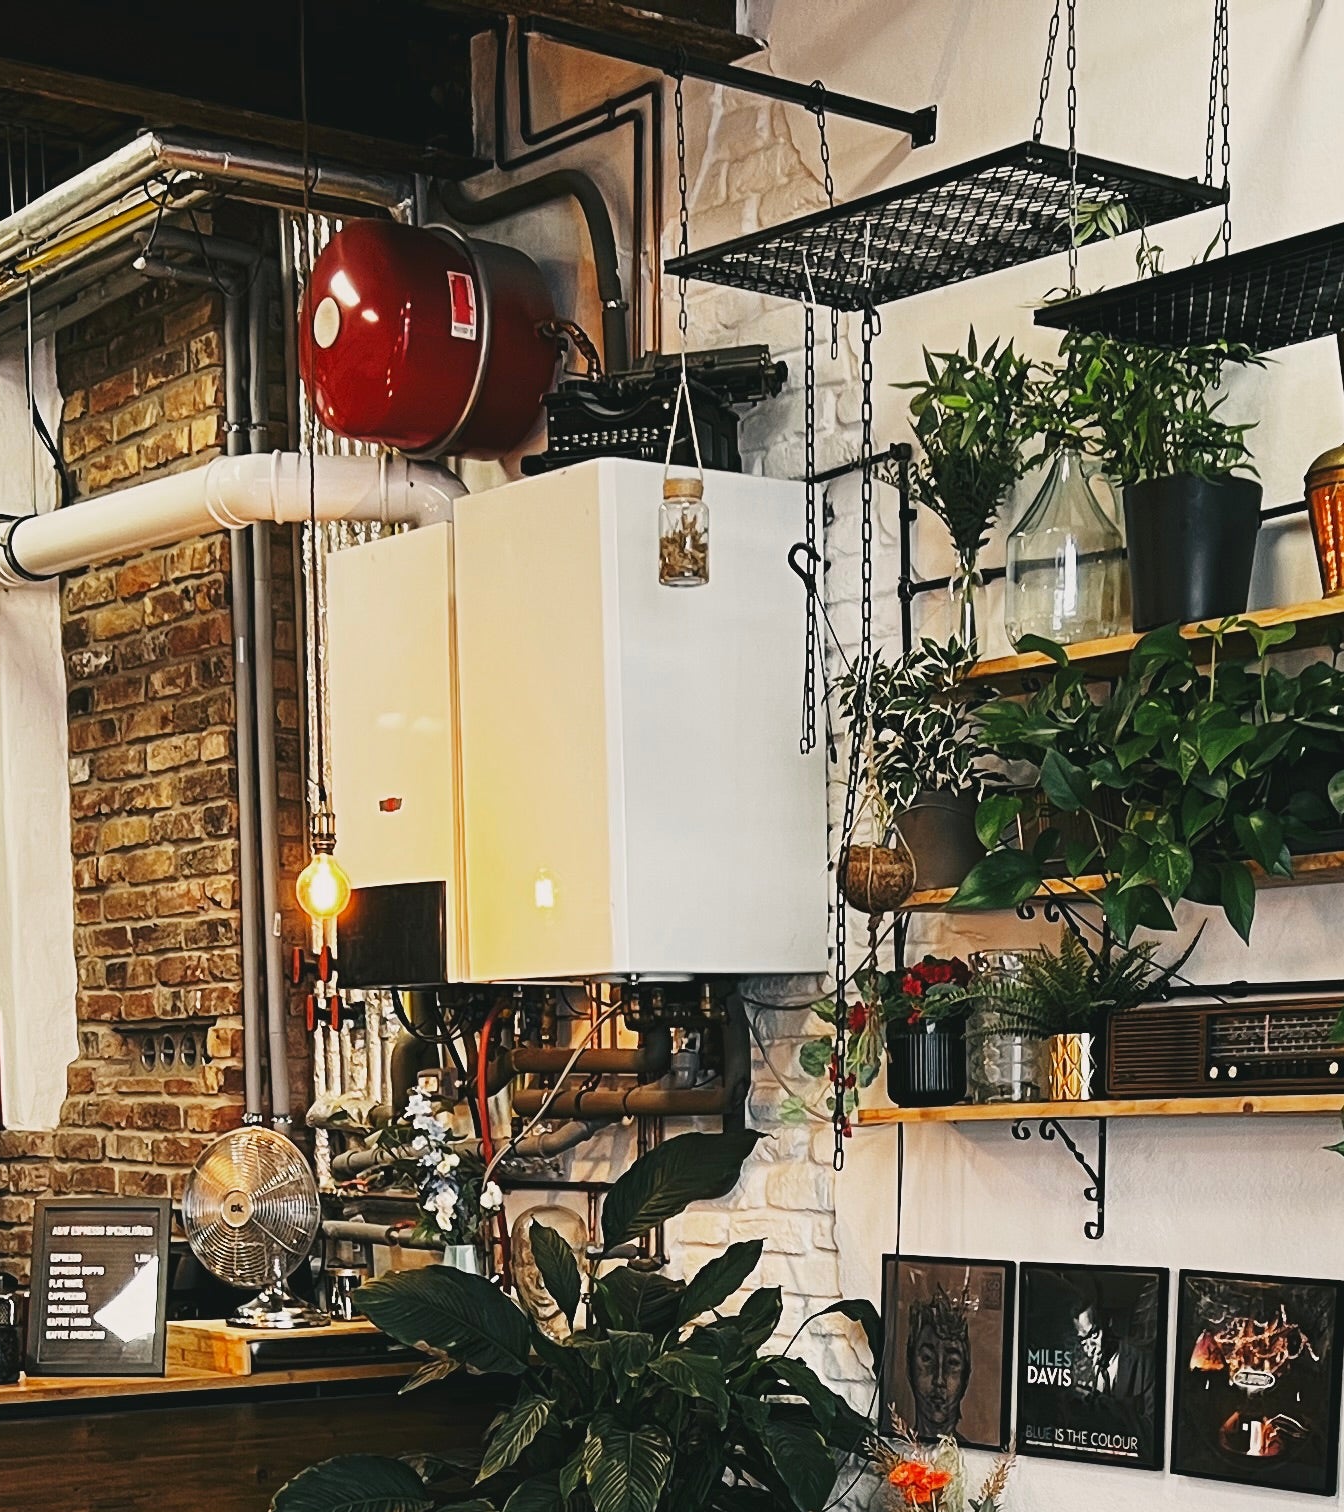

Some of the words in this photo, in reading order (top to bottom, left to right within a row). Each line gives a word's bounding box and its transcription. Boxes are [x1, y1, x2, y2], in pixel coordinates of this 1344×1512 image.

[231, 1203, 244, 1213] ok
[1027, 1349, 1072, 1367] MILES
[1027, 1366, 1072, 1387] DAVIS
[1026, 1425, 1051, 1440] BLUE
[1054, 1428, 1064, 1442] IS
[1067, 1429, 1088, 1445] THE
[1091, 1432, 1138, 1450] COLOUR
